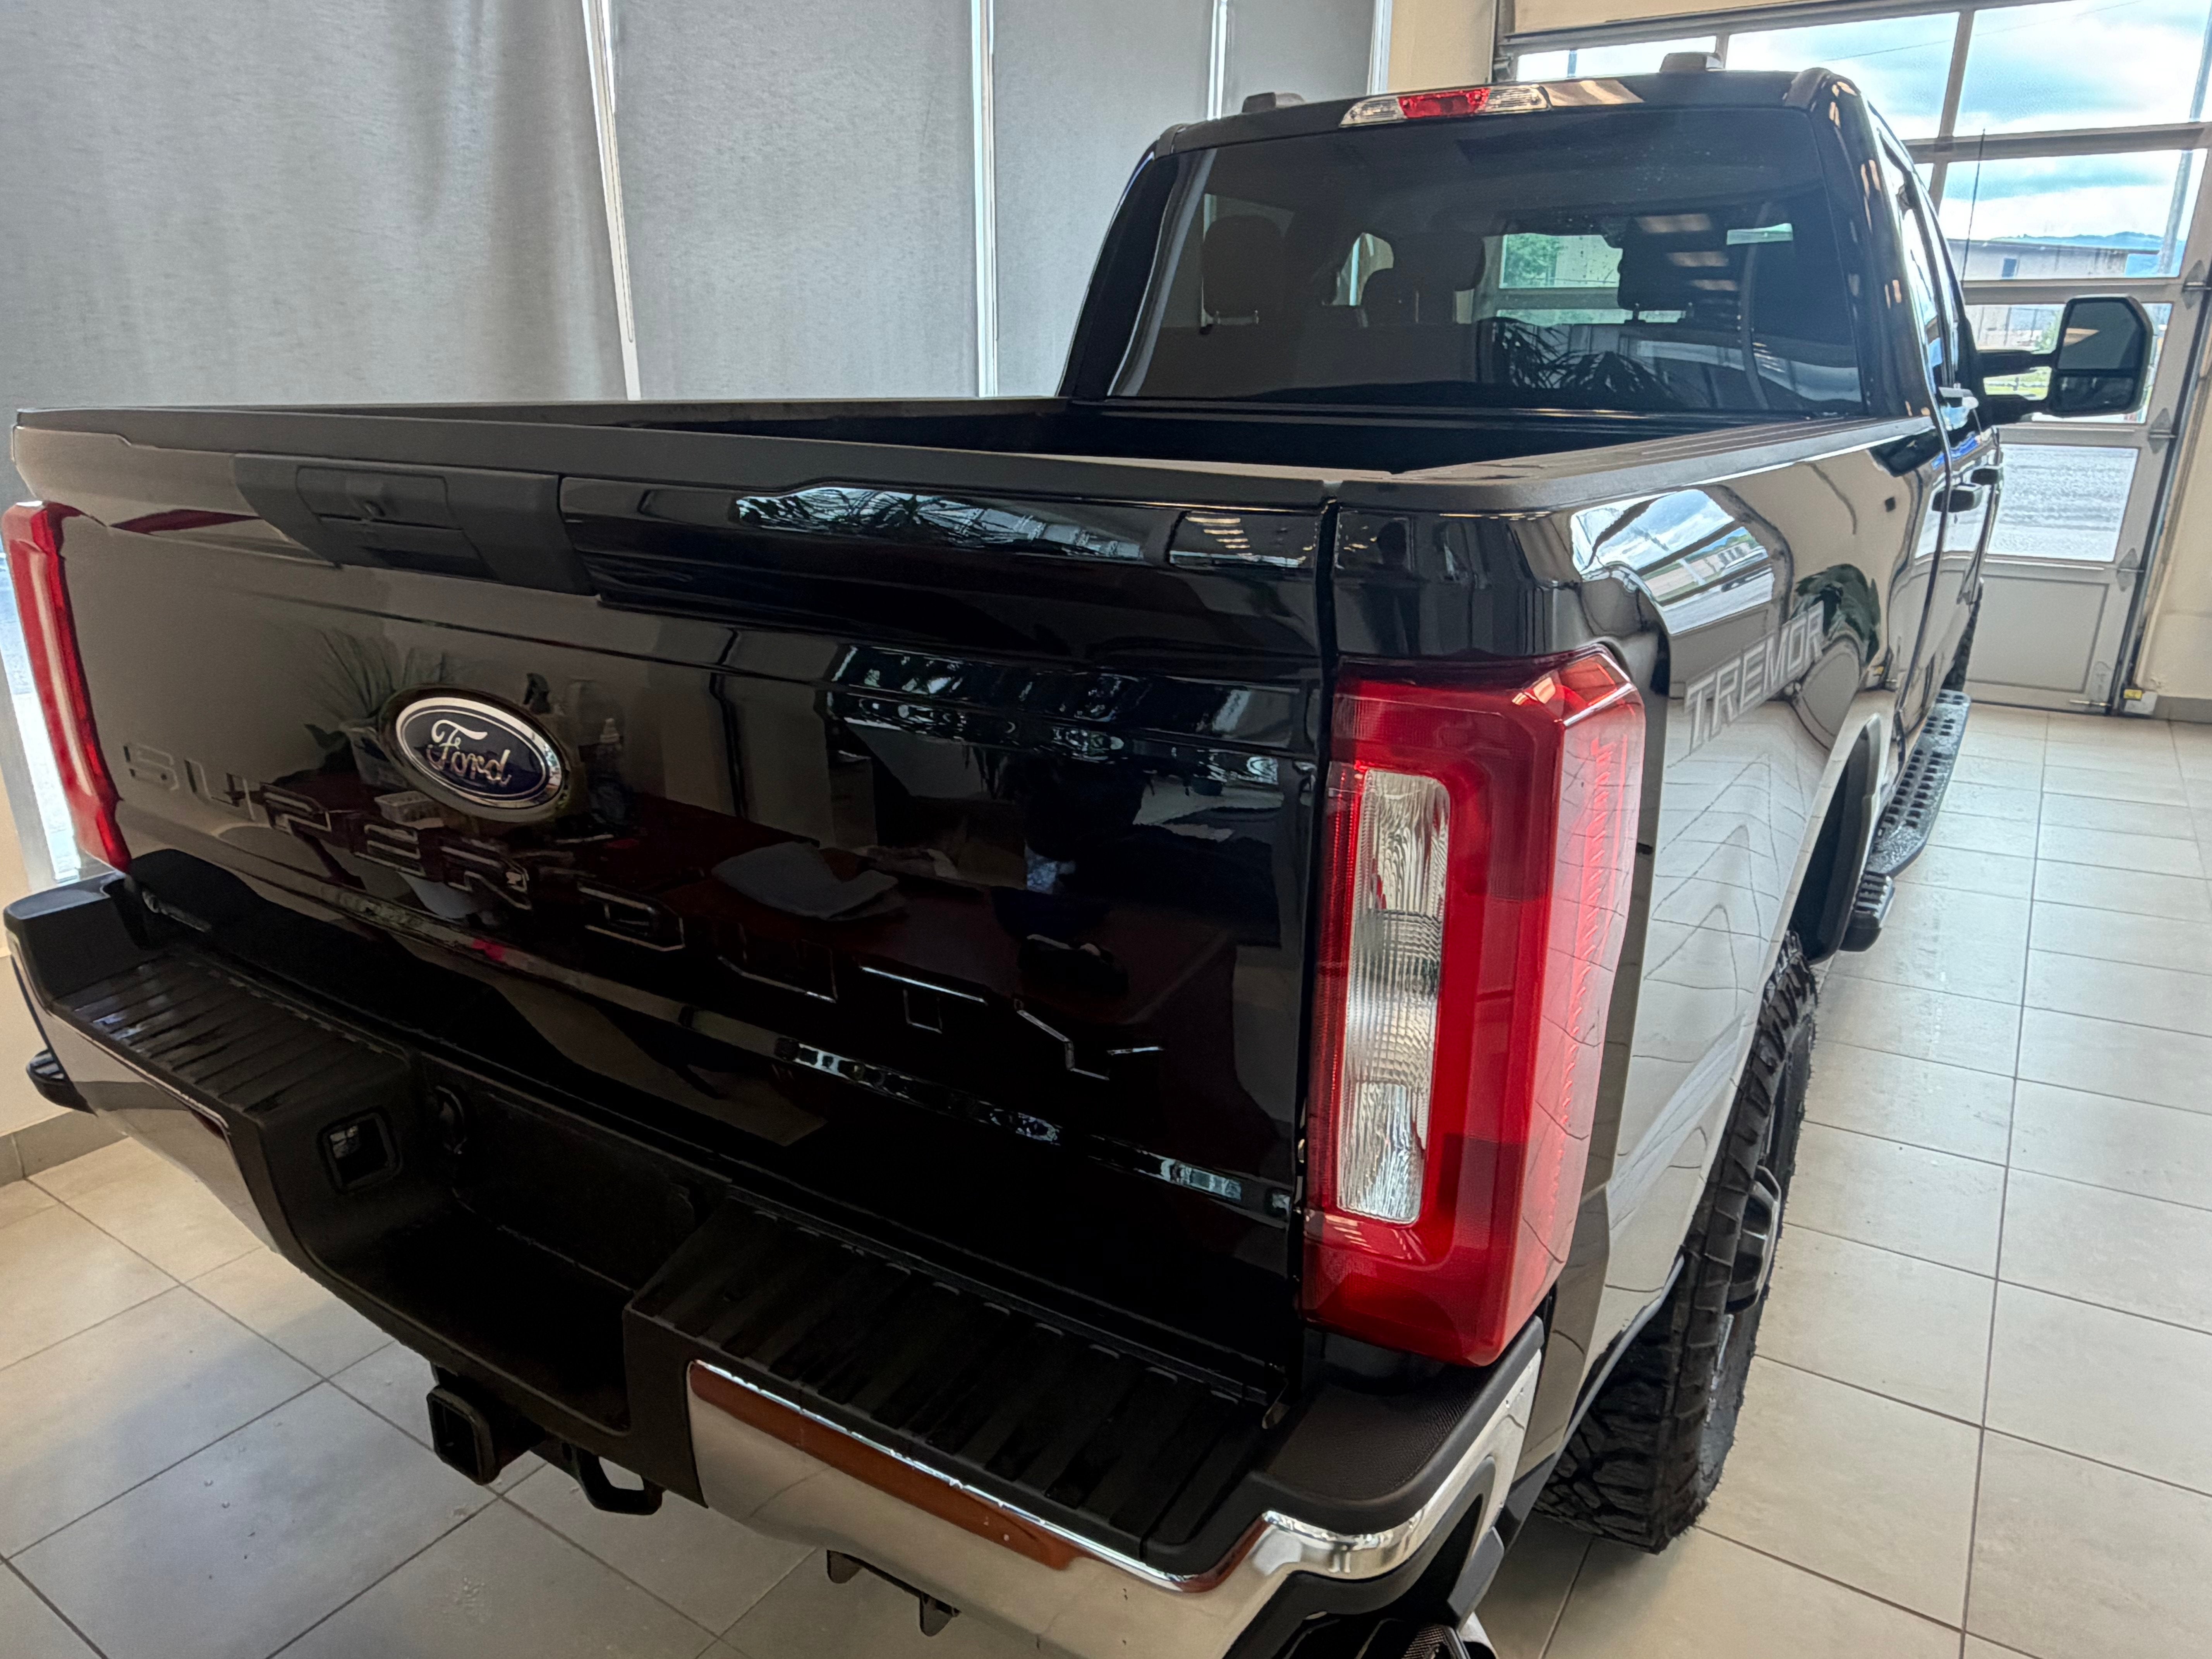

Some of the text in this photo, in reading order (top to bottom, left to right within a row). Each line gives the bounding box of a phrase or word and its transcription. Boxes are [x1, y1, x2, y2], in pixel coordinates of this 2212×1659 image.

[427, 719, 512, 787] Ford
[1685, 600, 1823, 756] TREMOR
[123, 742, 1164, 1081] SUPER DUTY
